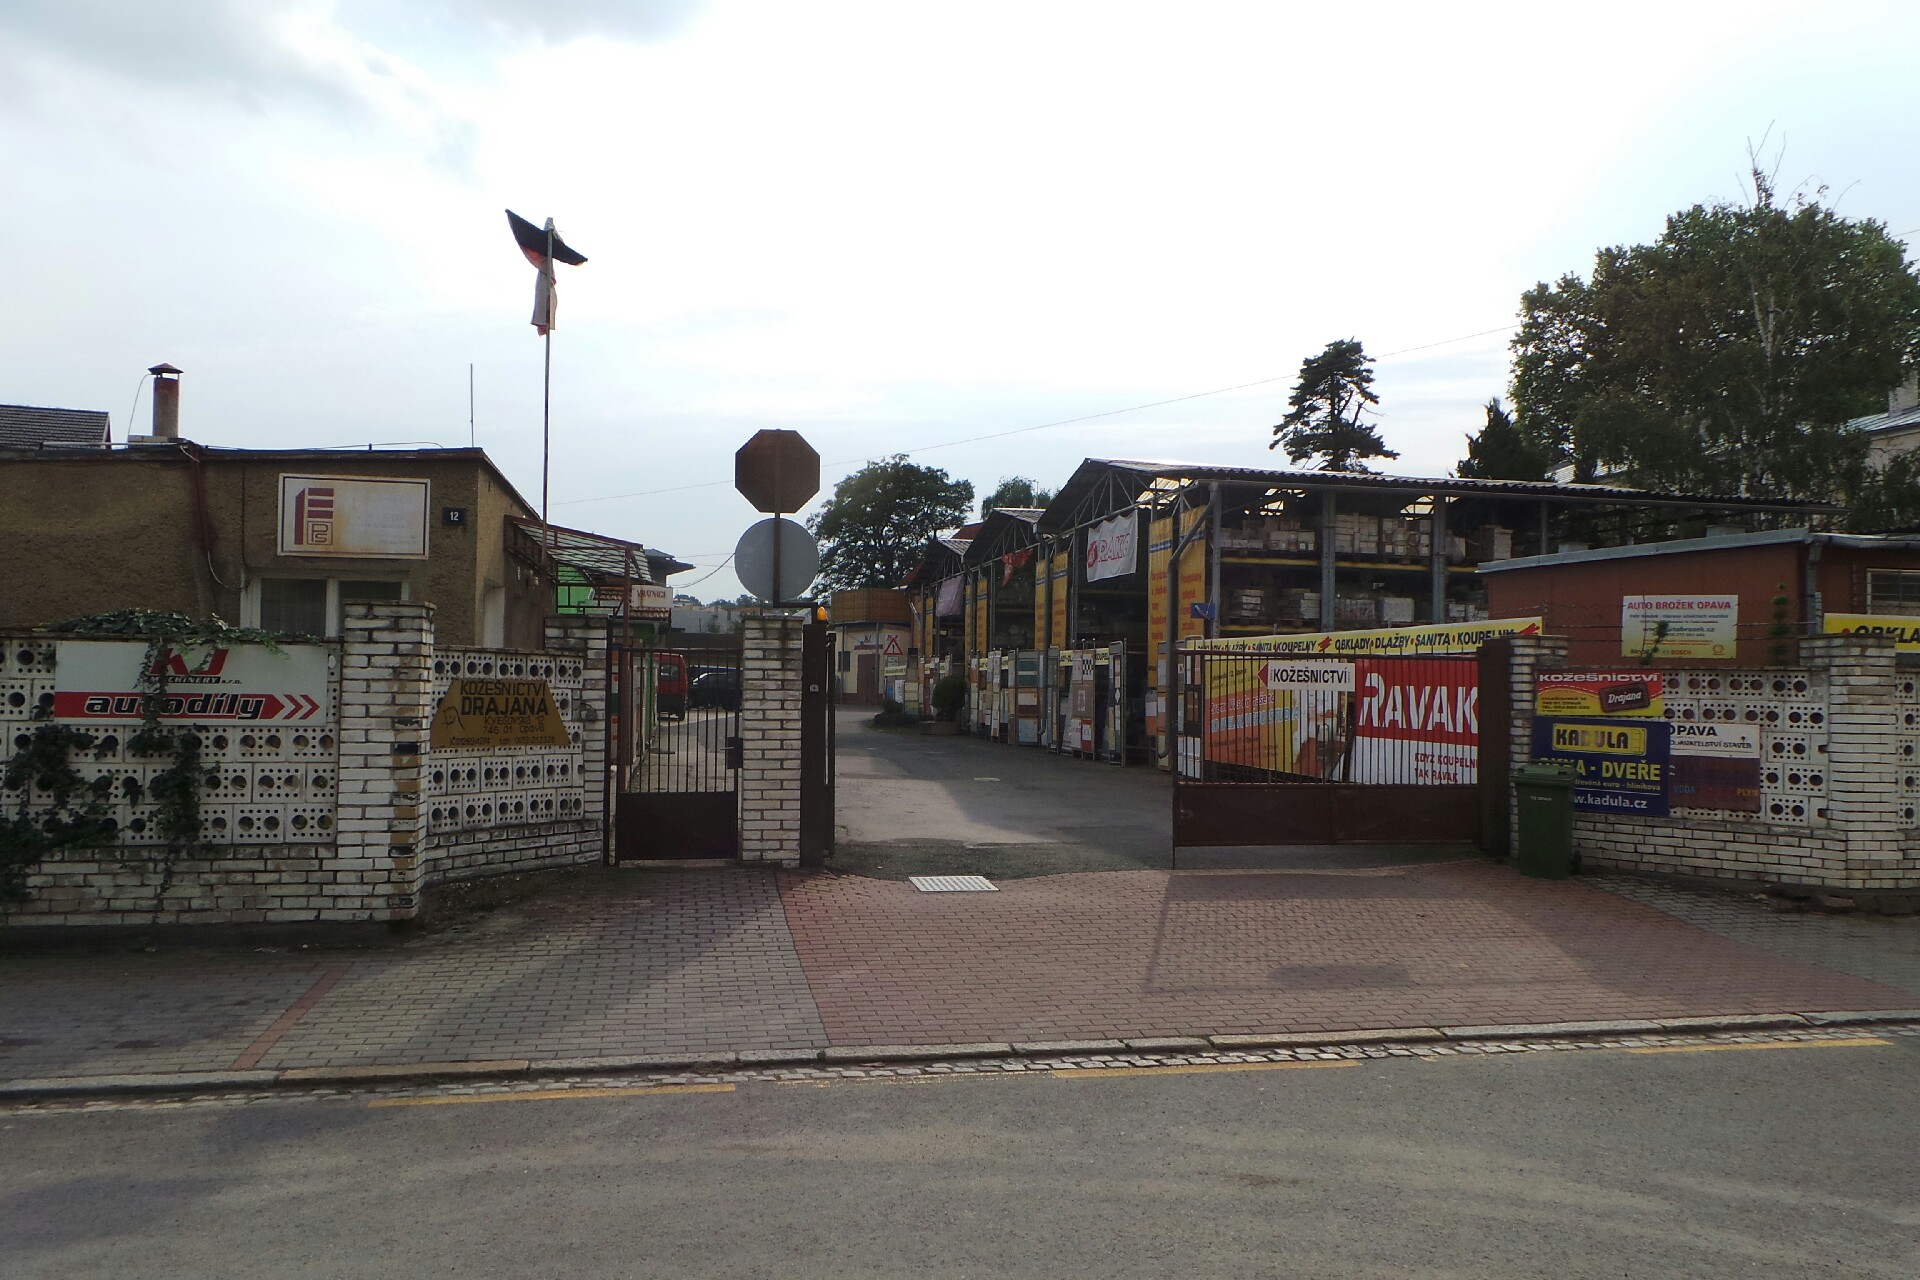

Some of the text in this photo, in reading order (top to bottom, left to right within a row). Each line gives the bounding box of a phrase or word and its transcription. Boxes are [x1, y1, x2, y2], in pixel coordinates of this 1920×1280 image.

[449, 511, 459, 521] 12
[1627, 599, 1731, 609] AUTO BROŽEK OPAVA
[1276, 641, 1317, 651] KOUPELNY
[1335, 638, 1370, 650] OBKLADY
[1374, 633, 1411, 649] DLAŽBY
[1415, 633, 1450, 647] SANITA
[150, 676, 220, 684] MCHINERY
[1273, 666, 1348, 684] KOŽEŠNICTVÍ
[1358, 673, 1479, 734] RAVAK
[1608, 691, 1642, 705] Drajana
[84, 693, 266, 720] auodíly
[461, 697, 548, 716] DRAJANA
[1555, 728, 1629, 749] KADULA
[1431, 770, 1458, 783] RAVAK
[1601, 760, 1661, 781] DVEŘE
[1574, 793, 1648, 808] w.kadula.cz
[1736, 788, 1758, 797] PLYN
